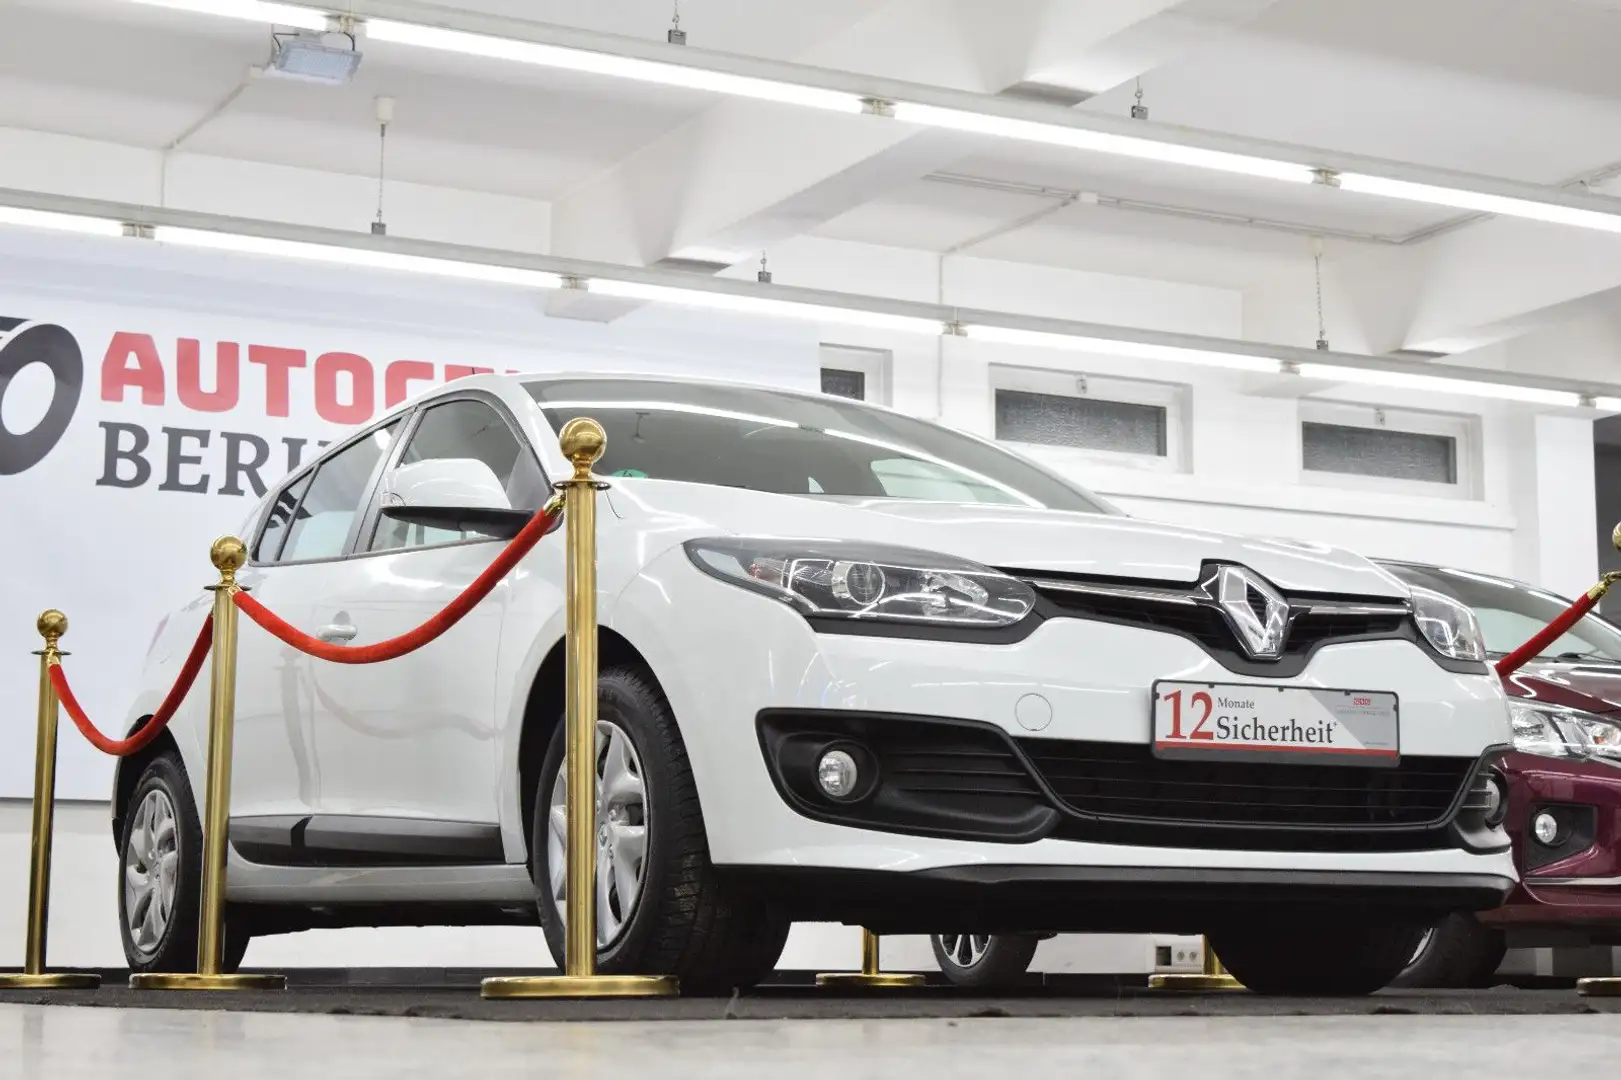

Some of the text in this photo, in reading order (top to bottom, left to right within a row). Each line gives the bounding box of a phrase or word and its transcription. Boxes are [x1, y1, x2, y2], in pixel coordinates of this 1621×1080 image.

[101, 331, 520, 425] AUTOC
[1163, 689, 1214, 741] 12
[1217, 697, 1255, 710] Monate
